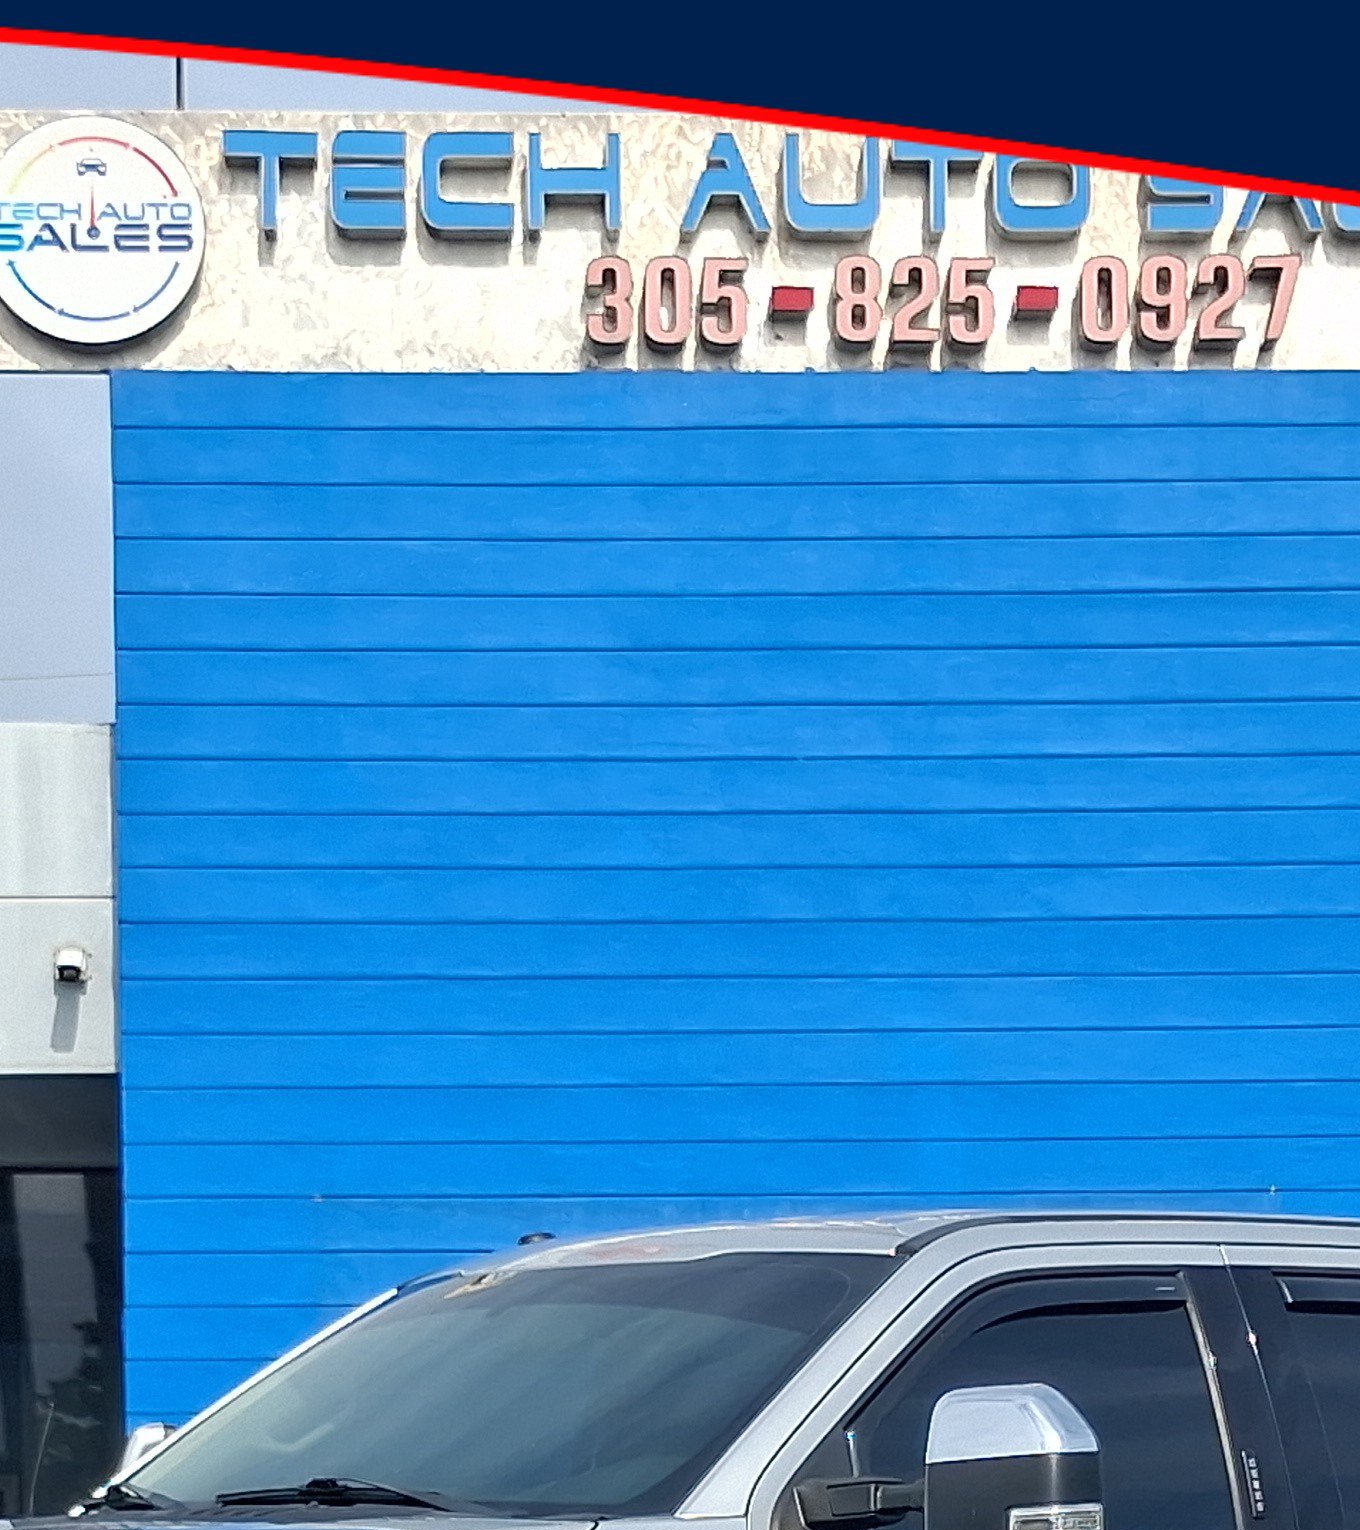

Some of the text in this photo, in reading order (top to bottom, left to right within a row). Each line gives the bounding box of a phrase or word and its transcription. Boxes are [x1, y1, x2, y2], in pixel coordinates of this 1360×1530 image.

[223, 130, 622, 231] TECH
[681, 133, 1091, 232] AUTO
[97, 202, 193, 221] AUTO
